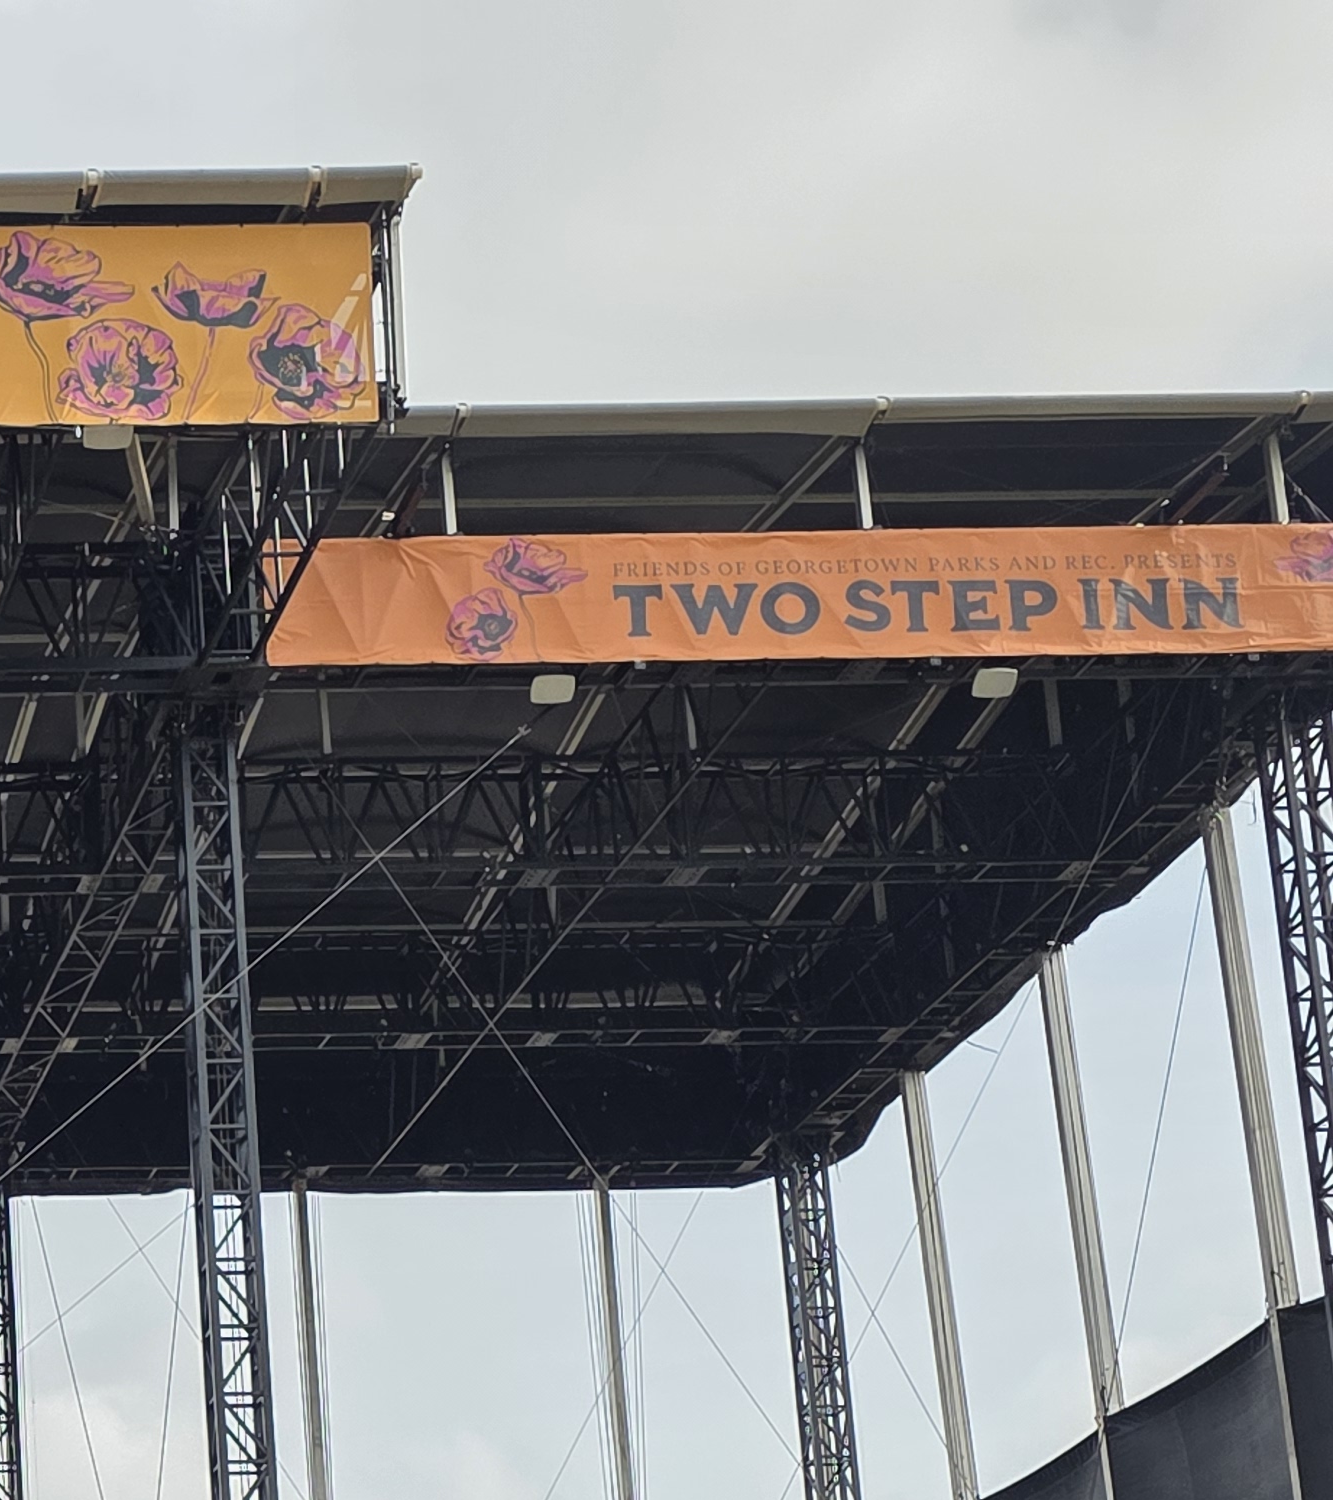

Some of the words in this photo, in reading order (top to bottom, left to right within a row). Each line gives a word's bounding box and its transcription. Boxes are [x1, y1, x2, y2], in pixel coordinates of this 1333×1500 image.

[612, 561, 711, 578] FRIENDS
[717, 560, 745, 577] OF
[754, 557, 918, 575] GEORGETOWN
[928, 556, 1000, 573] PARKS
[1008, 555, 1057, 571] AND
[1064, 554, 1115, 571] REC.
[1123, 551, 1239, 570] PRESENTS
[612, 581, 821, 636] TWO
[844, 579, 1058, 633] STEP
[1076, 577, 1242, 631] INN
